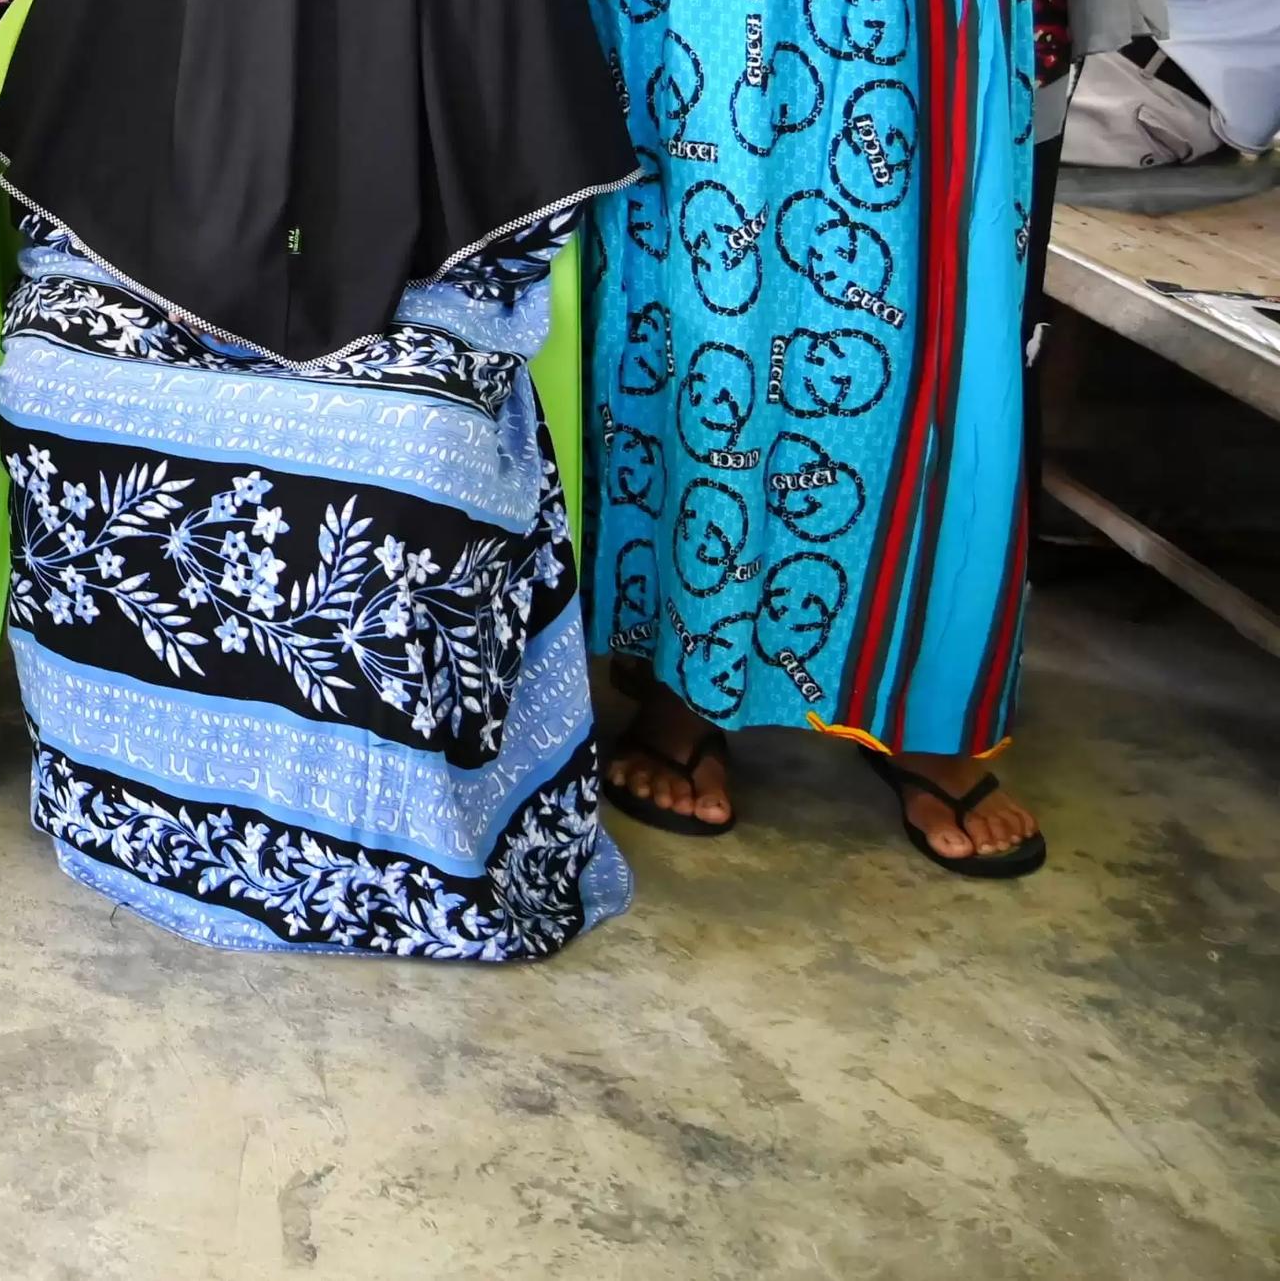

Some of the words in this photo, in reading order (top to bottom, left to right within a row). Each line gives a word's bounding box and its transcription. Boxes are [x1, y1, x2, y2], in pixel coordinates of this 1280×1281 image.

[746, 16, 763, 86] GUCCI
[855, 118, 890, 184] GUCCI
[728, 202, 769, 250] GUCC
[846, 285, 905, 327] GUCCI
[768, 338, 787, 402] GUCCI
[772, 469, 835, 490] GUCCI
[778, 650, 822, 703] GUCCI
